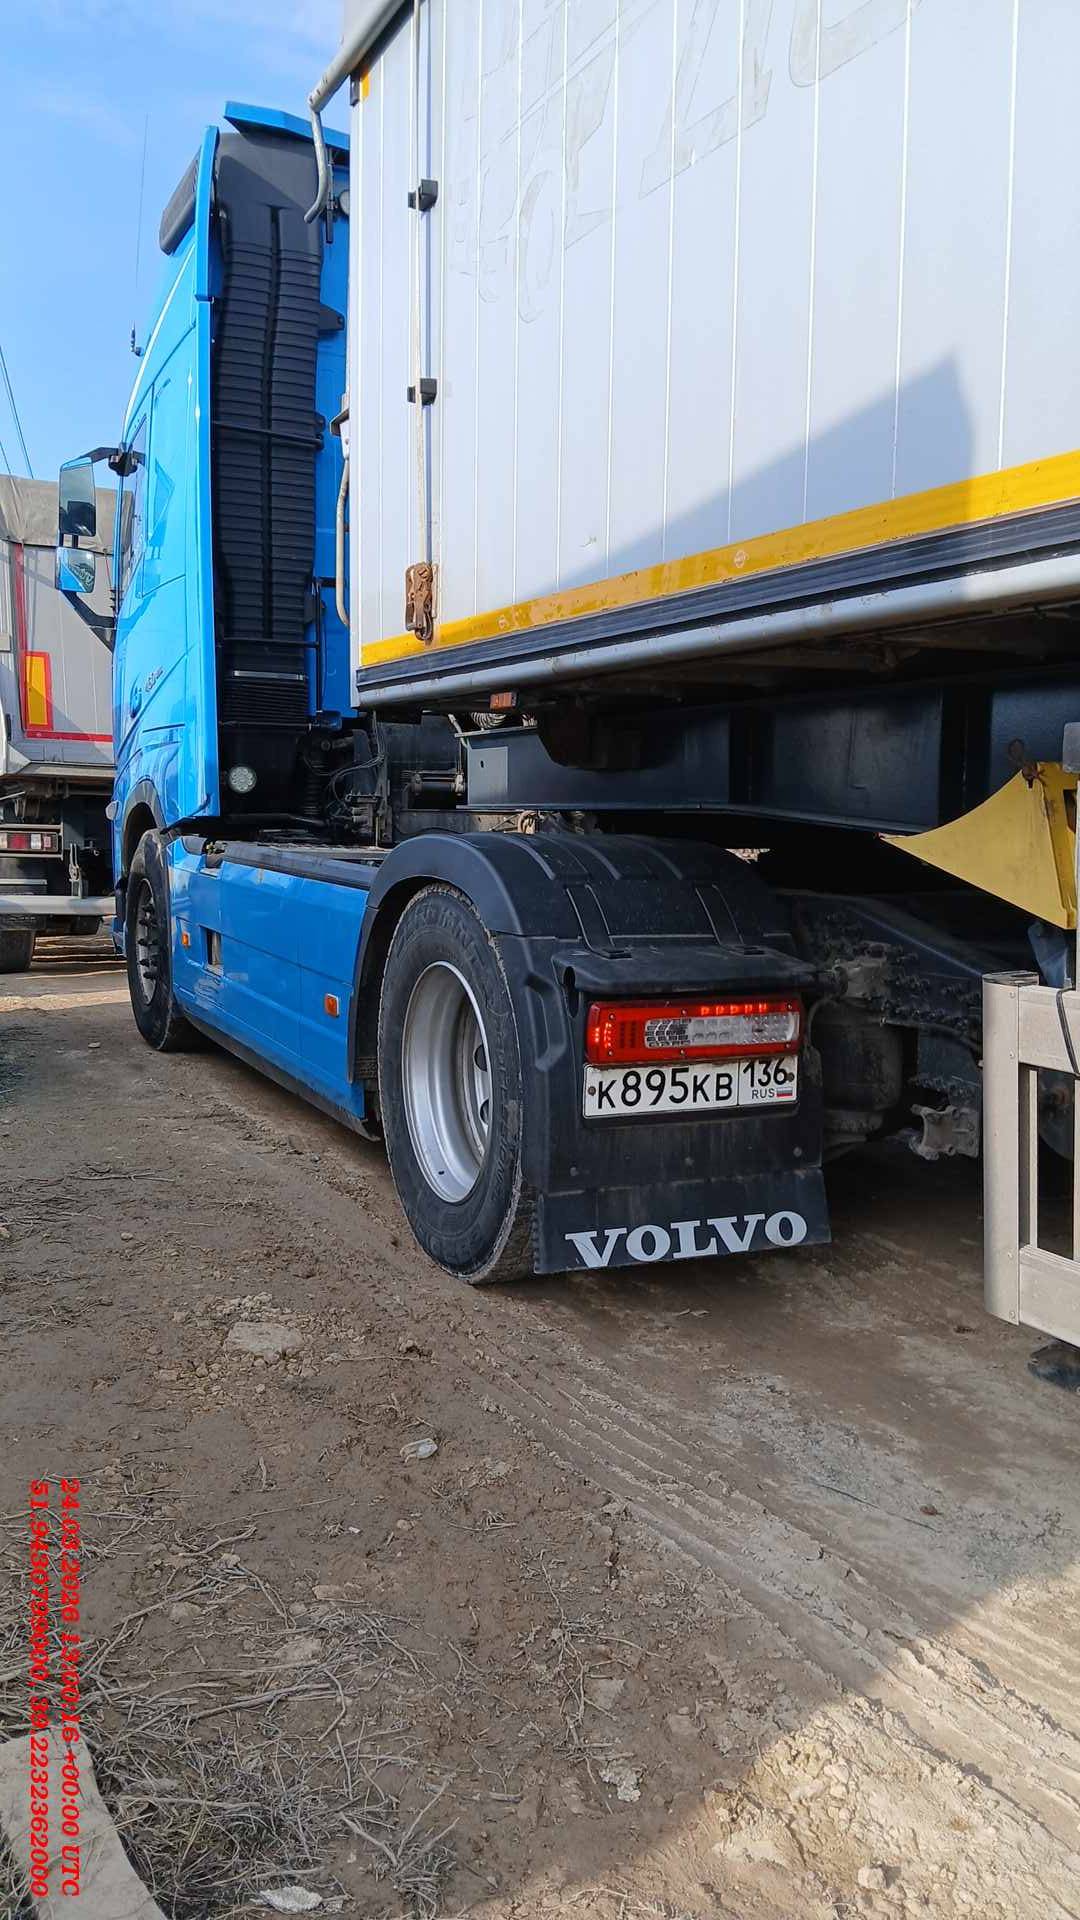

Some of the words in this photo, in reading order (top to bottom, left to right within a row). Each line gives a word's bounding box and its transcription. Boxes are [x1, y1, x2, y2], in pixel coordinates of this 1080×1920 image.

[743, 1058, 788, 1087] 136
[751, 1088, 776, 1100] RUS
[564, 1210, 808, 1269] VOLVO
